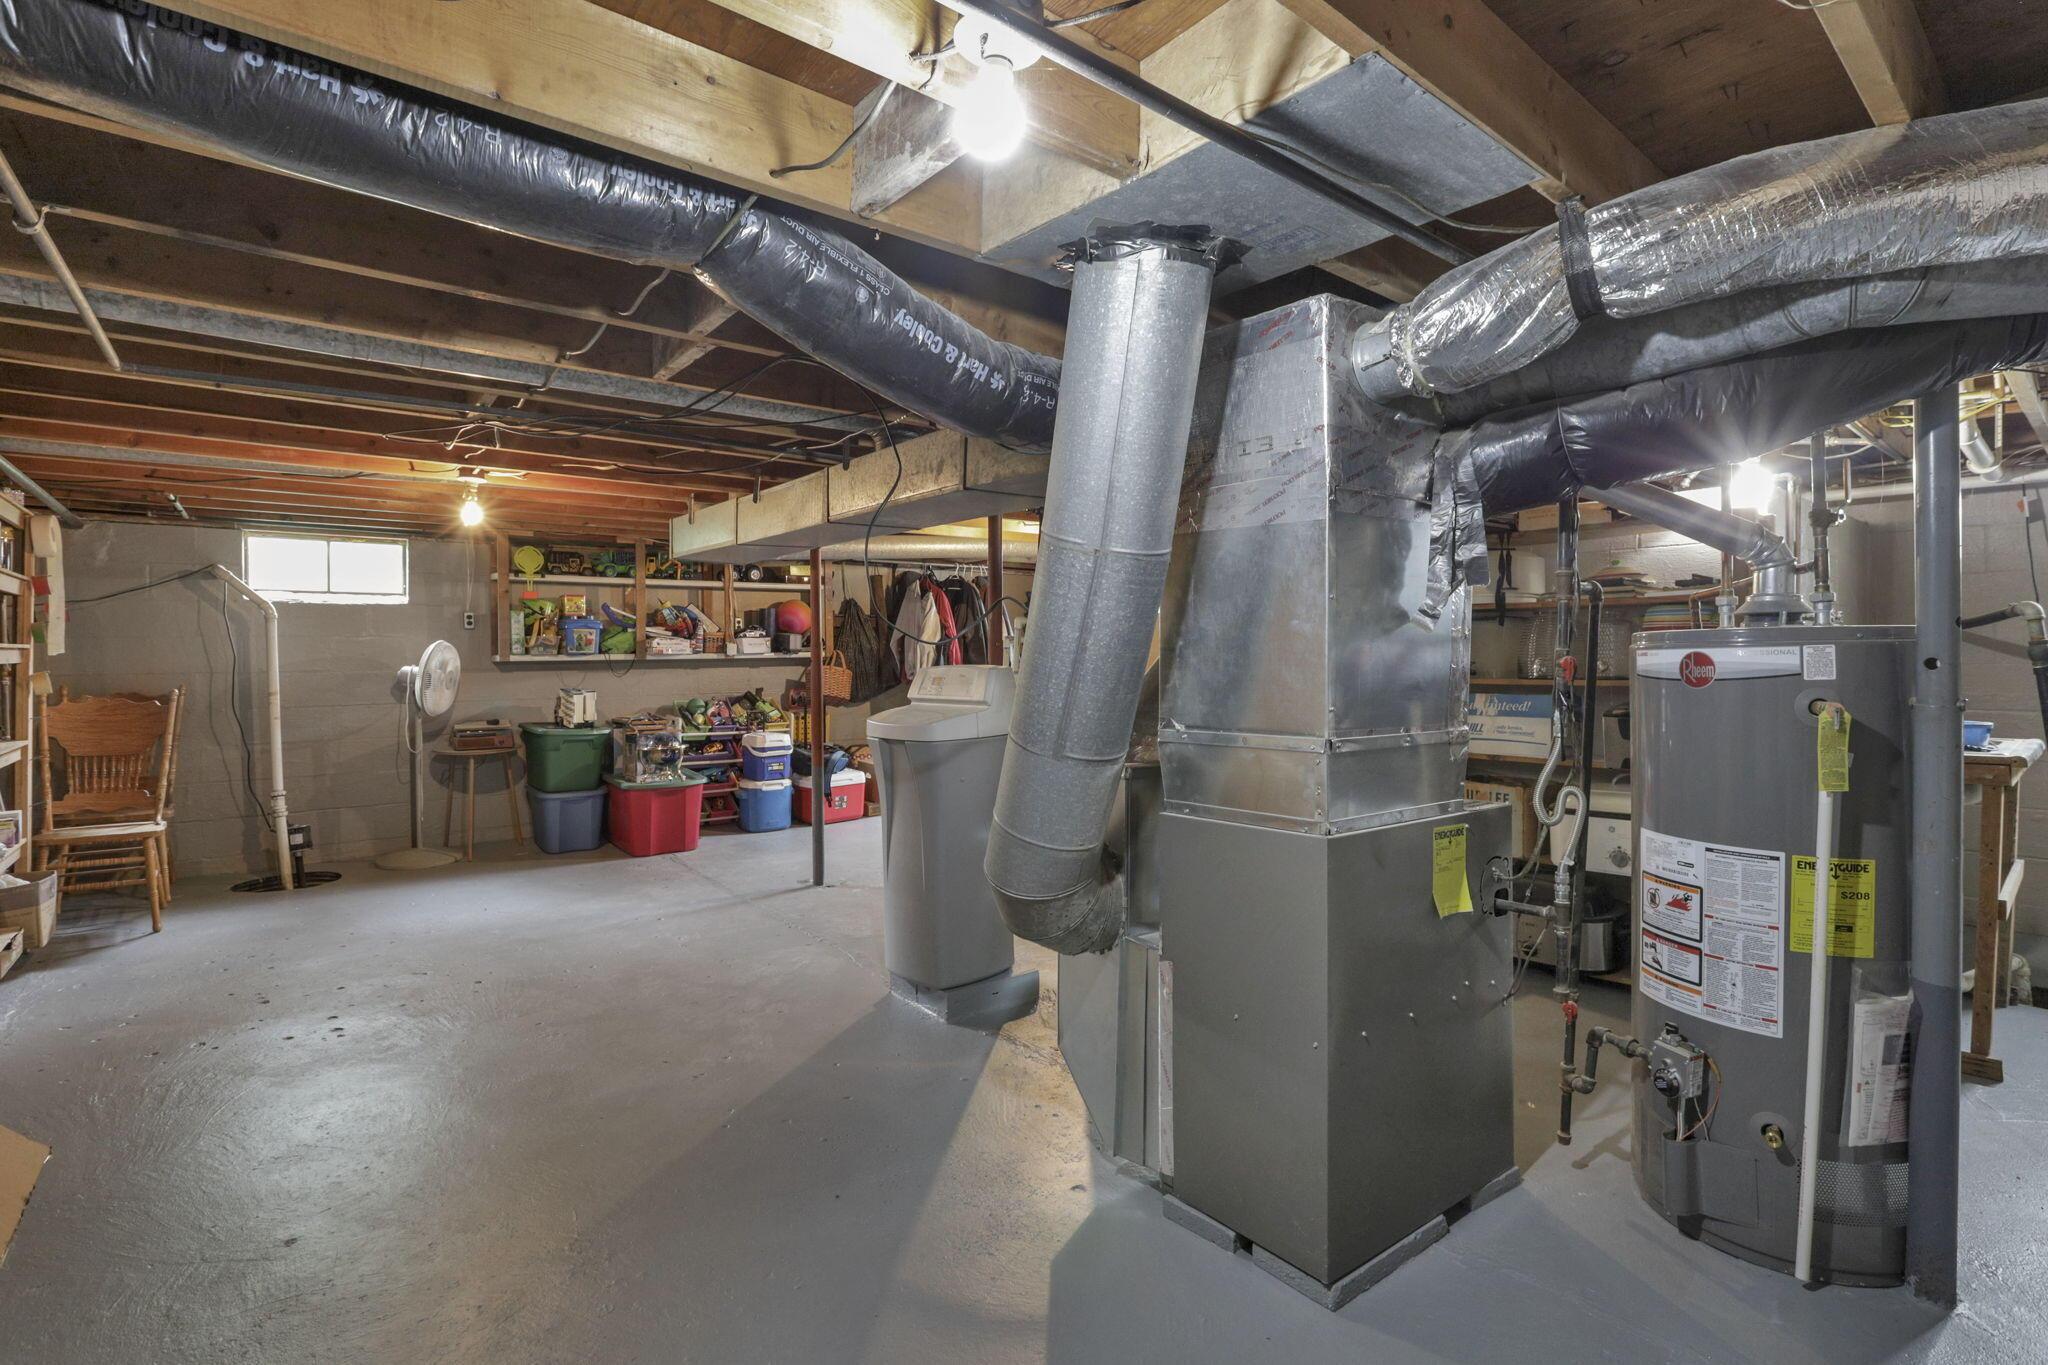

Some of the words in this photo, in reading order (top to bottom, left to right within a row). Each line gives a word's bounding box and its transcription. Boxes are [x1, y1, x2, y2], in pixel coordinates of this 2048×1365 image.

[780, 216, 805, 234] DUCT
[805, 232, 821, 246] AIR
[785, 239, 827, 276] R-4.2
[820, 243, 858, 272] FLEXIBLE
[866, 274, 890, 295] CLASS
[945, 342, 958, 363] &
[957, 352, 989, 382] Hart
[1683, 653, 1715, 682] Rheem
[1797, 860, 1871, 873] ENEYGUIDE
